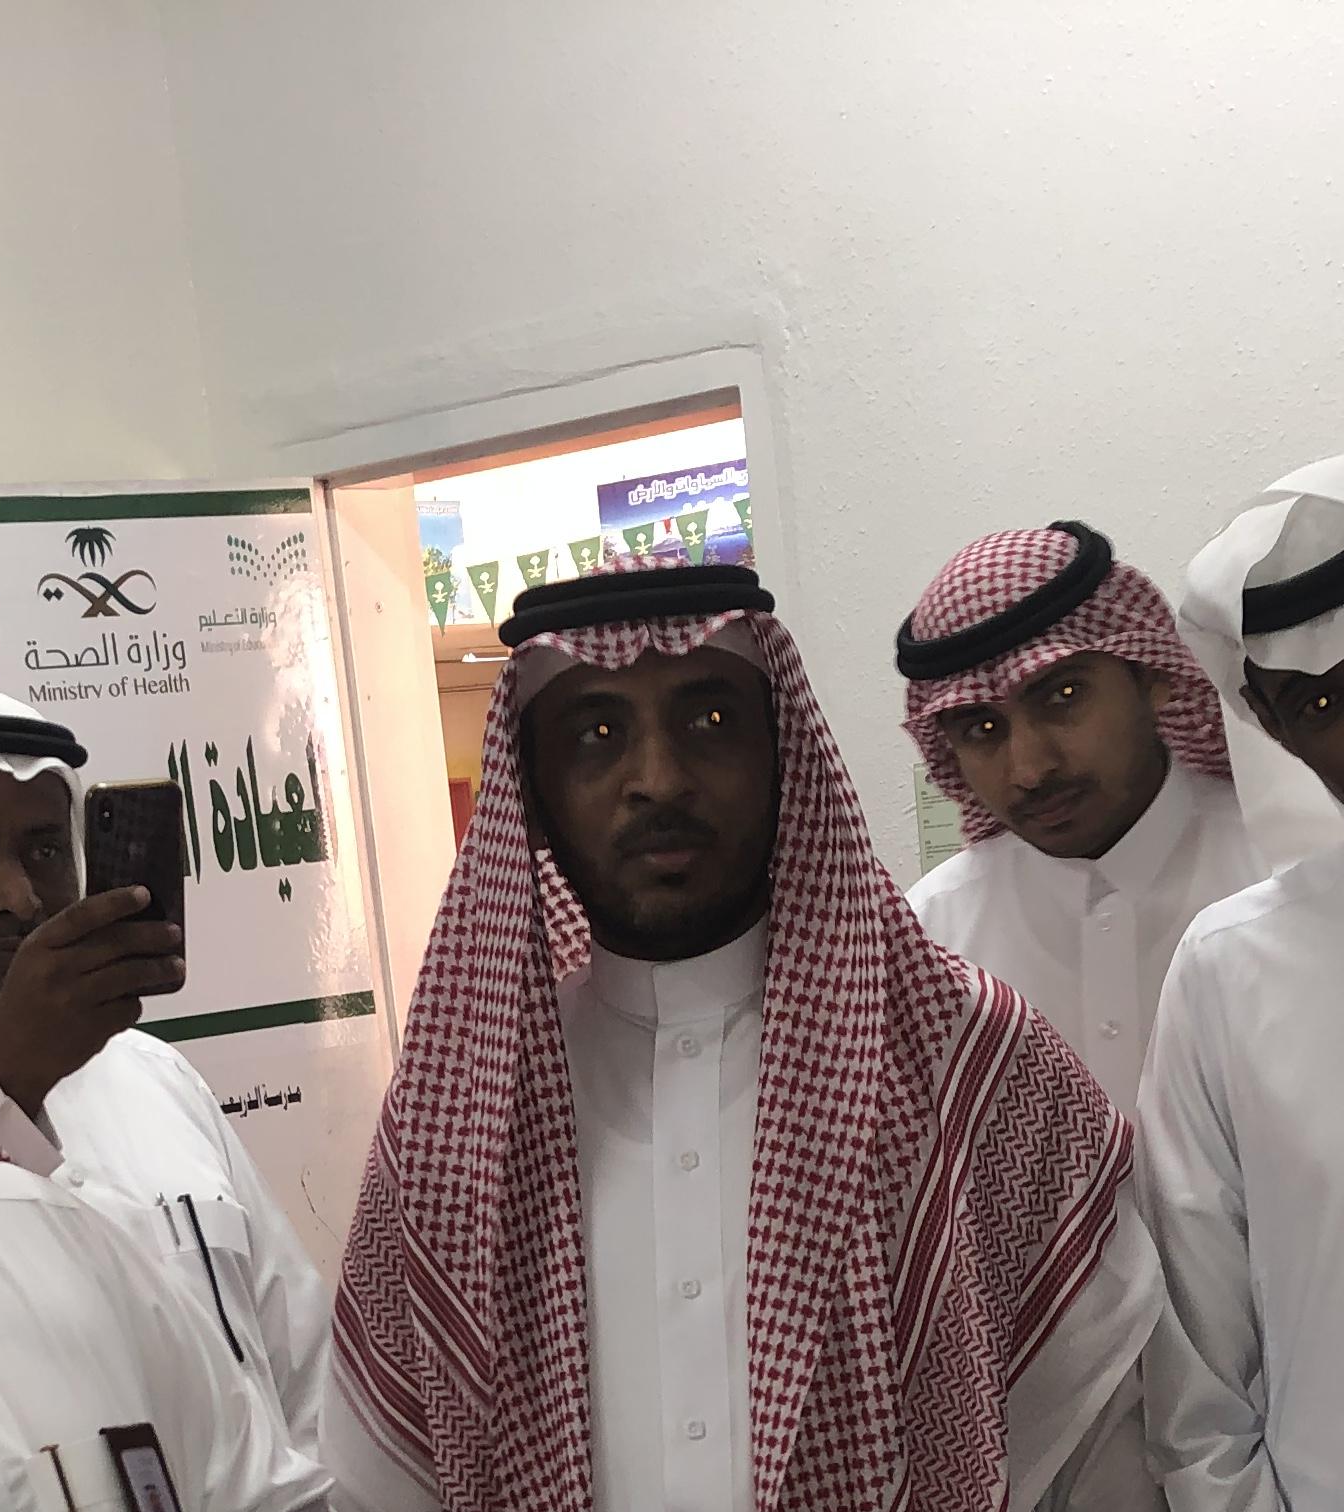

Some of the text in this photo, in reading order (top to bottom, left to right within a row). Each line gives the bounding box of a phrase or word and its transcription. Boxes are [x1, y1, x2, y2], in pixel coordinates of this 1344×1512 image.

[198, 606, 277, 632] وزارة التعليم
[24, 630, 188, 673] وزارة الصحة
[28, 673, 191, 703] Ministry of Health
[219, 1083, 302, 1118] مدرسة الدريع
